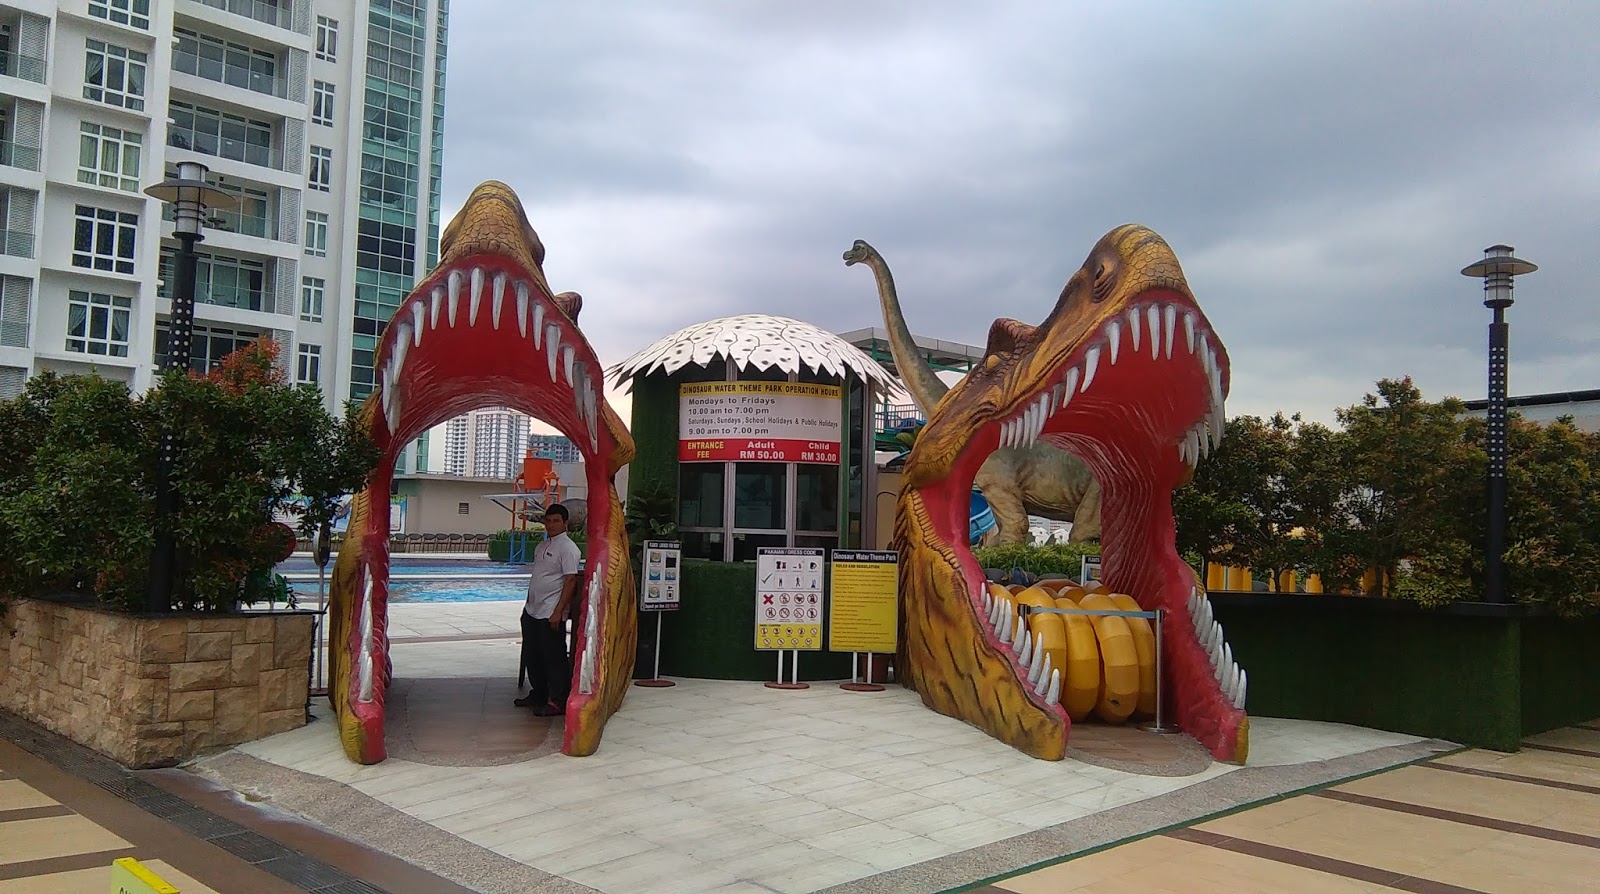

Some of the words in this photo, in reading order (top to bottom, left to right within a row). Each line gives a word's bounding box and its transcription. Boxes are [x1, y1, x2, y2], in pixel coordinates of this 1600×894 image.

[683, 385, 712, 394] DINOSAUR
[714, 384, 737, 393] WATER
[739, 384, 762, 392] THEME
[765, 384, 783, 393] PARK
[785, 385, 819, 395] OPERATION
[820, 388, 839, 397] HOURS
[688, 397, 724, 406] Mondays
[741, 396, 776, 406] Fridays
[688, 407, 709, 415] 10.00
[735, 406, 754, 414] 7.00
[755, 407, 770, 415] pm
[745, 416, 766, 425] School
[768, 417, 793, 426] Holidays
[794, 417, 800, 425] &
[801, 418, 818, 426] Public
[819, 419, 839, 429] Holidays
[688, 427, 706, 435] 9.00
[733, 426, 752, 435] 7.00
[754, 427, 770, 435] pm
[687, 441, 725, 450] ENTRANCE
[747, 441, 776, 449] Adult
[808, 442, 830, 450] Child
[696, 450, 710, 459] FEE
[739, 450, 755, 459] RM
[757, 450, 785, 460] 50.00
[801, 451, 814, 461] RM
[815, 452, 837, 462] 30.00
[833, 551, 855, 560] Dinosaur
[855, 552, 870, 560] Water
[870, 553, 886, 561] Theme
